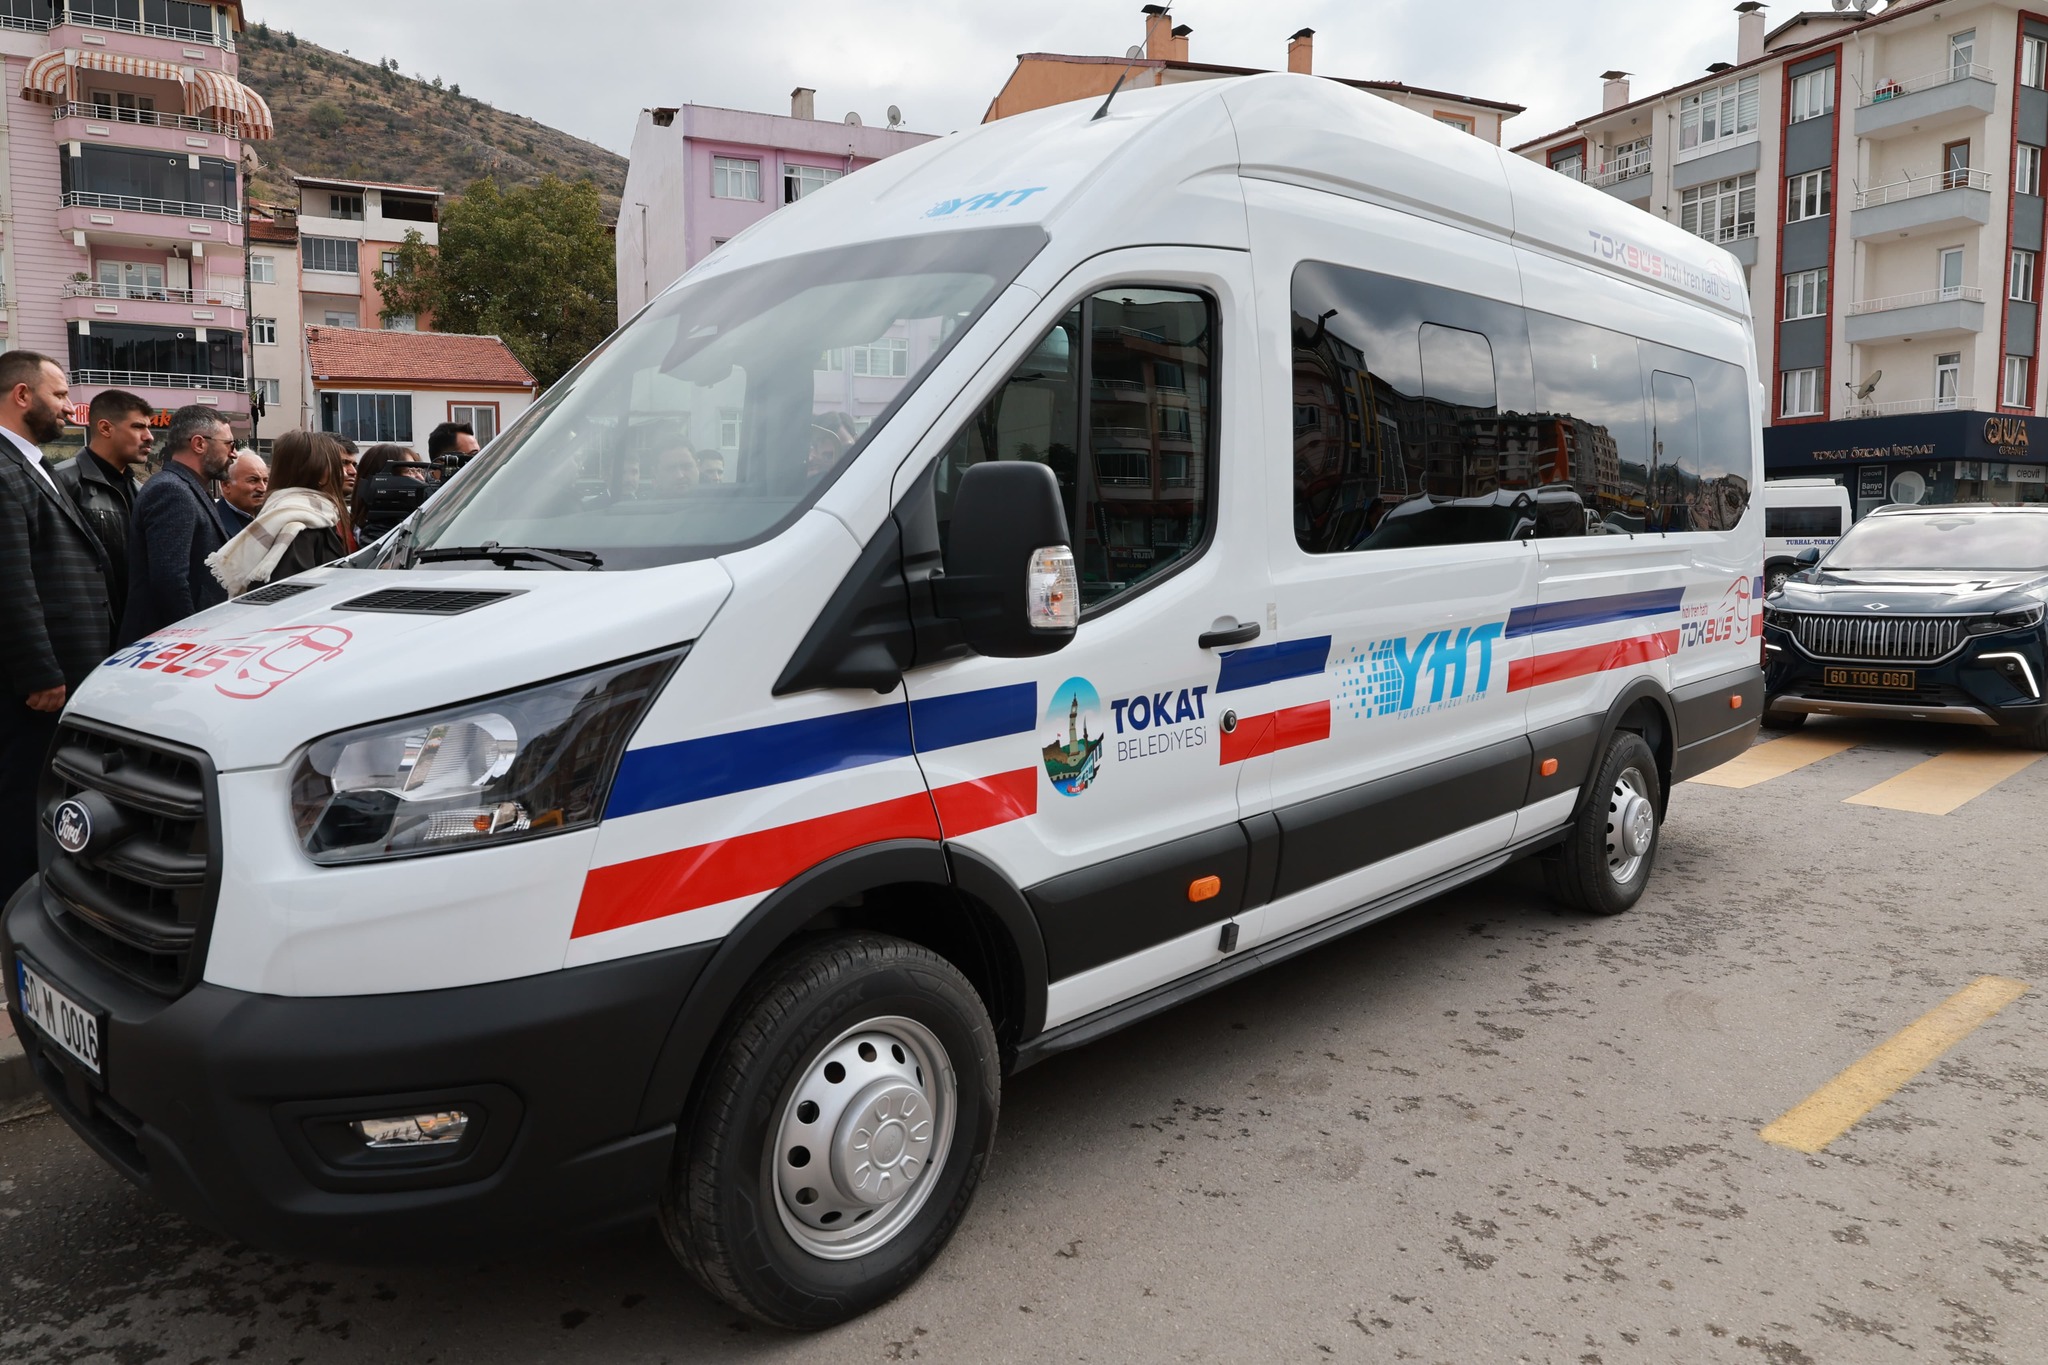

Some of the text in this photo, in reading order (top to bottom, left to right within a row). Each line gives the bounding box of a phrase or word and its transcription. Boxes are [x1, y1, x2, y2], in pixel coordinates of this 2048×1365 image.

[944, 186, 1048, 215] YHT
[1589, 230, 1662, 277] TOKBÜS
[1683, 265, 1701, 290] tren
[1984, 417, 2029, 446] QUA
[1812, 450, 1849, 460] TOKAT
[1851, 446, 1891, 459] ÖZCAN
[1861, 482, 1883, 491] Banyo
[2016, 468, 2040, 478] creavit
[1681, 616, 1733, 648] TOKBÜS
[103, 641, 252, 679] OKBÜS
[1393, 621, 1505, 711] YHT
[1831, 671, 1908, 687] 60 TOG 060
[1110, 685, 1208, 734] TOKAT
[1117, 725, 1207, 762] BELEDİYESİ
[58, 807, 83, 845] Ford
[23, 969, 99, 1067] 60 M 0016
